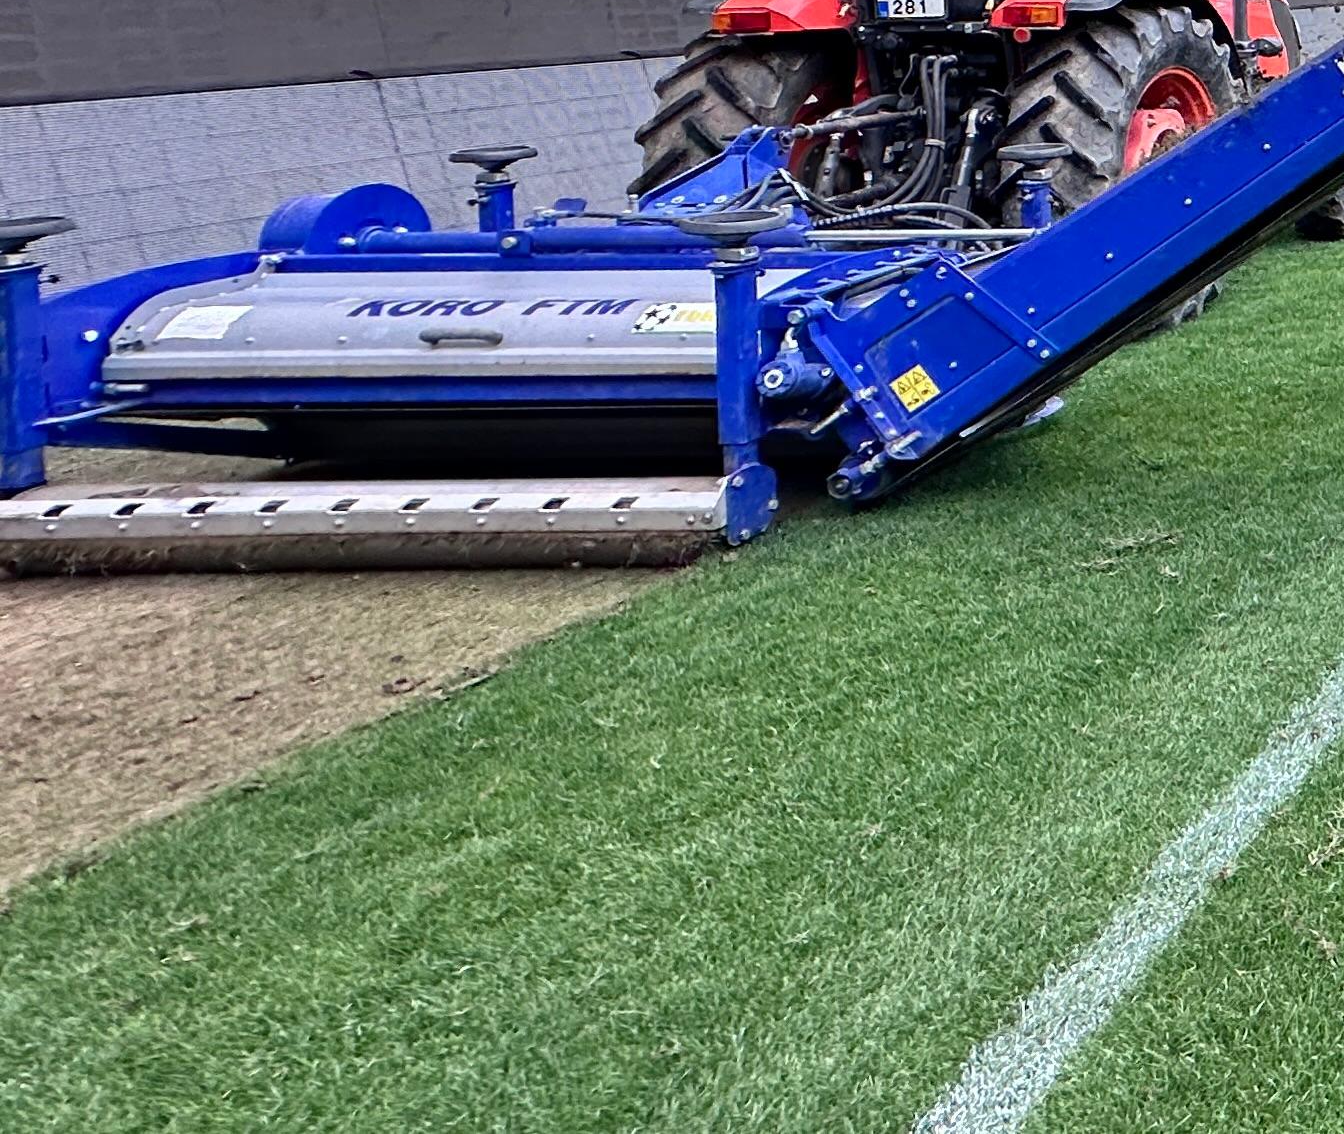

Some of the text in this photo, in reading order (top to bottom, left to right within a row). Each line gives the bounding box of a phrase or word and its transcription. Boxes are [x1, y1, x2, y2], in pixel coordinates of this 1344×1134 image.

[893, 0, 926, 15] 281
[346, 298, 641, 317] KORO FTM
